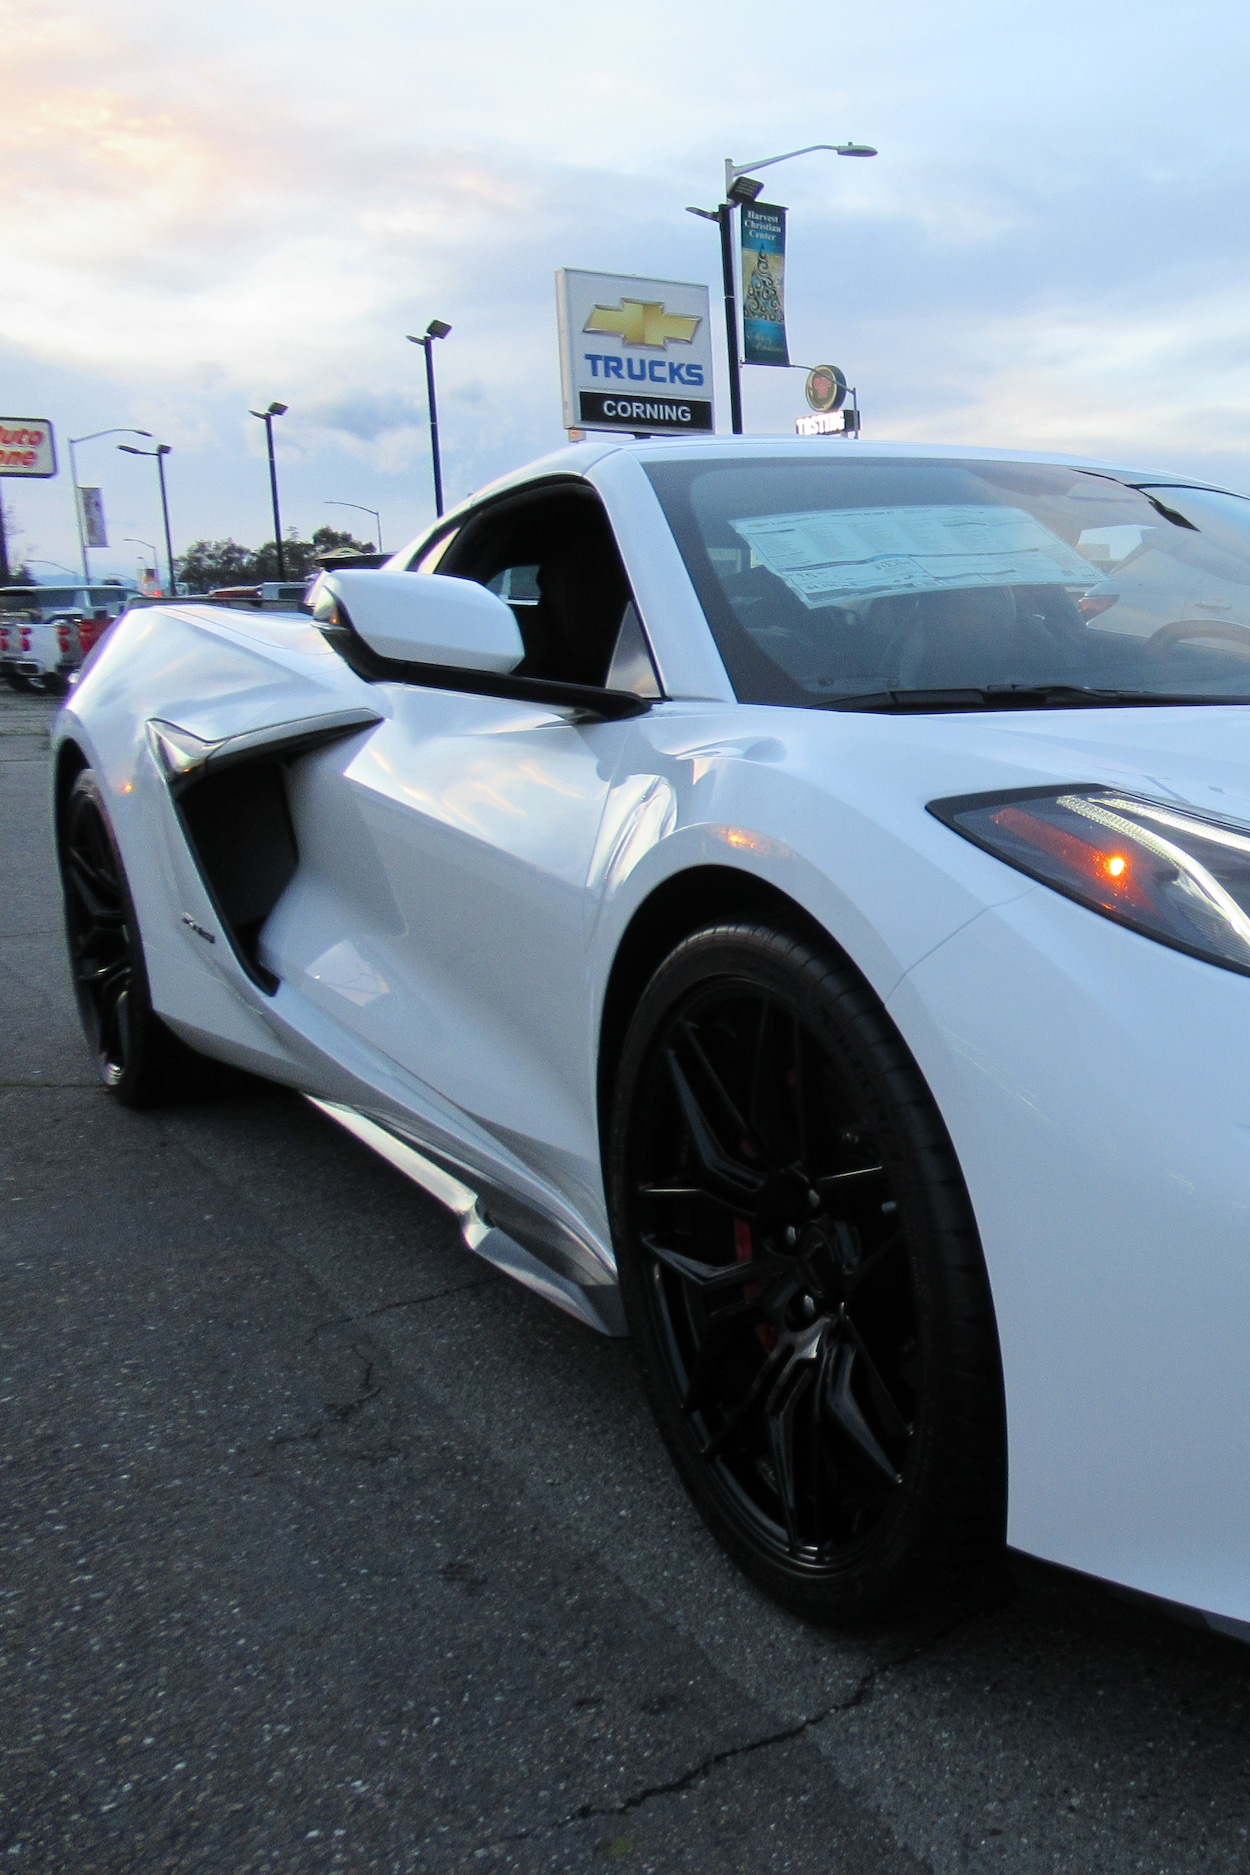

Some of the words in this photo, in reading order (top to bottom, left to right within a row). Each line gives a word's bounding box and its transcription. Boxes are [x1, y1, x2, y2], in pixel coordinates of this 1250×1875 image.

[748, 210, 779, 223] Harvest
[744, 220, 782, 233] Christian
[749, 230, 776, 241] Center
[584, 353, 705, 387] TRUCKS
[603, 400, 692, 422] CORNING
[0, 425, 44, 446] uto
